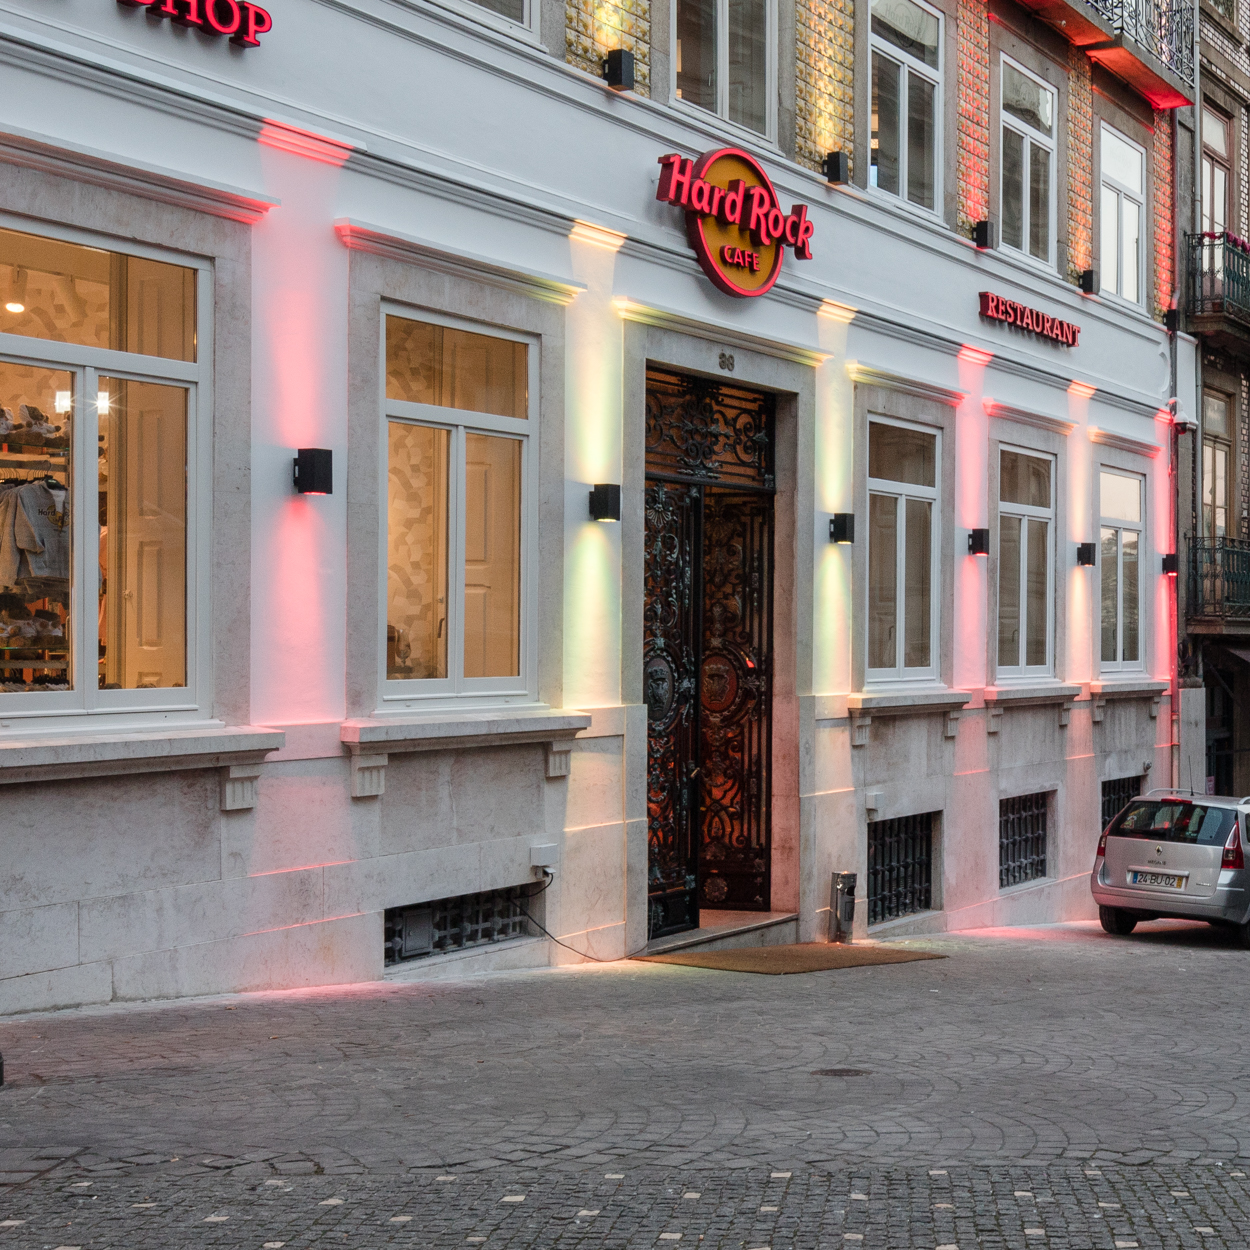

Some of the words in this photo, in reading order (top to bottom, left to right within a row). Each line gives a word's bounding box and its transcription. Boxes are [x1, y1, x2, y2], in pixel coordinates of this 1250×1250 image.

[667, 153, 747, 225] Hard
[748, 185, 815, 261] Rock
[722, 244, 761, 272] CAFE
[984, 292, 1082, 347] RESTAURANT
